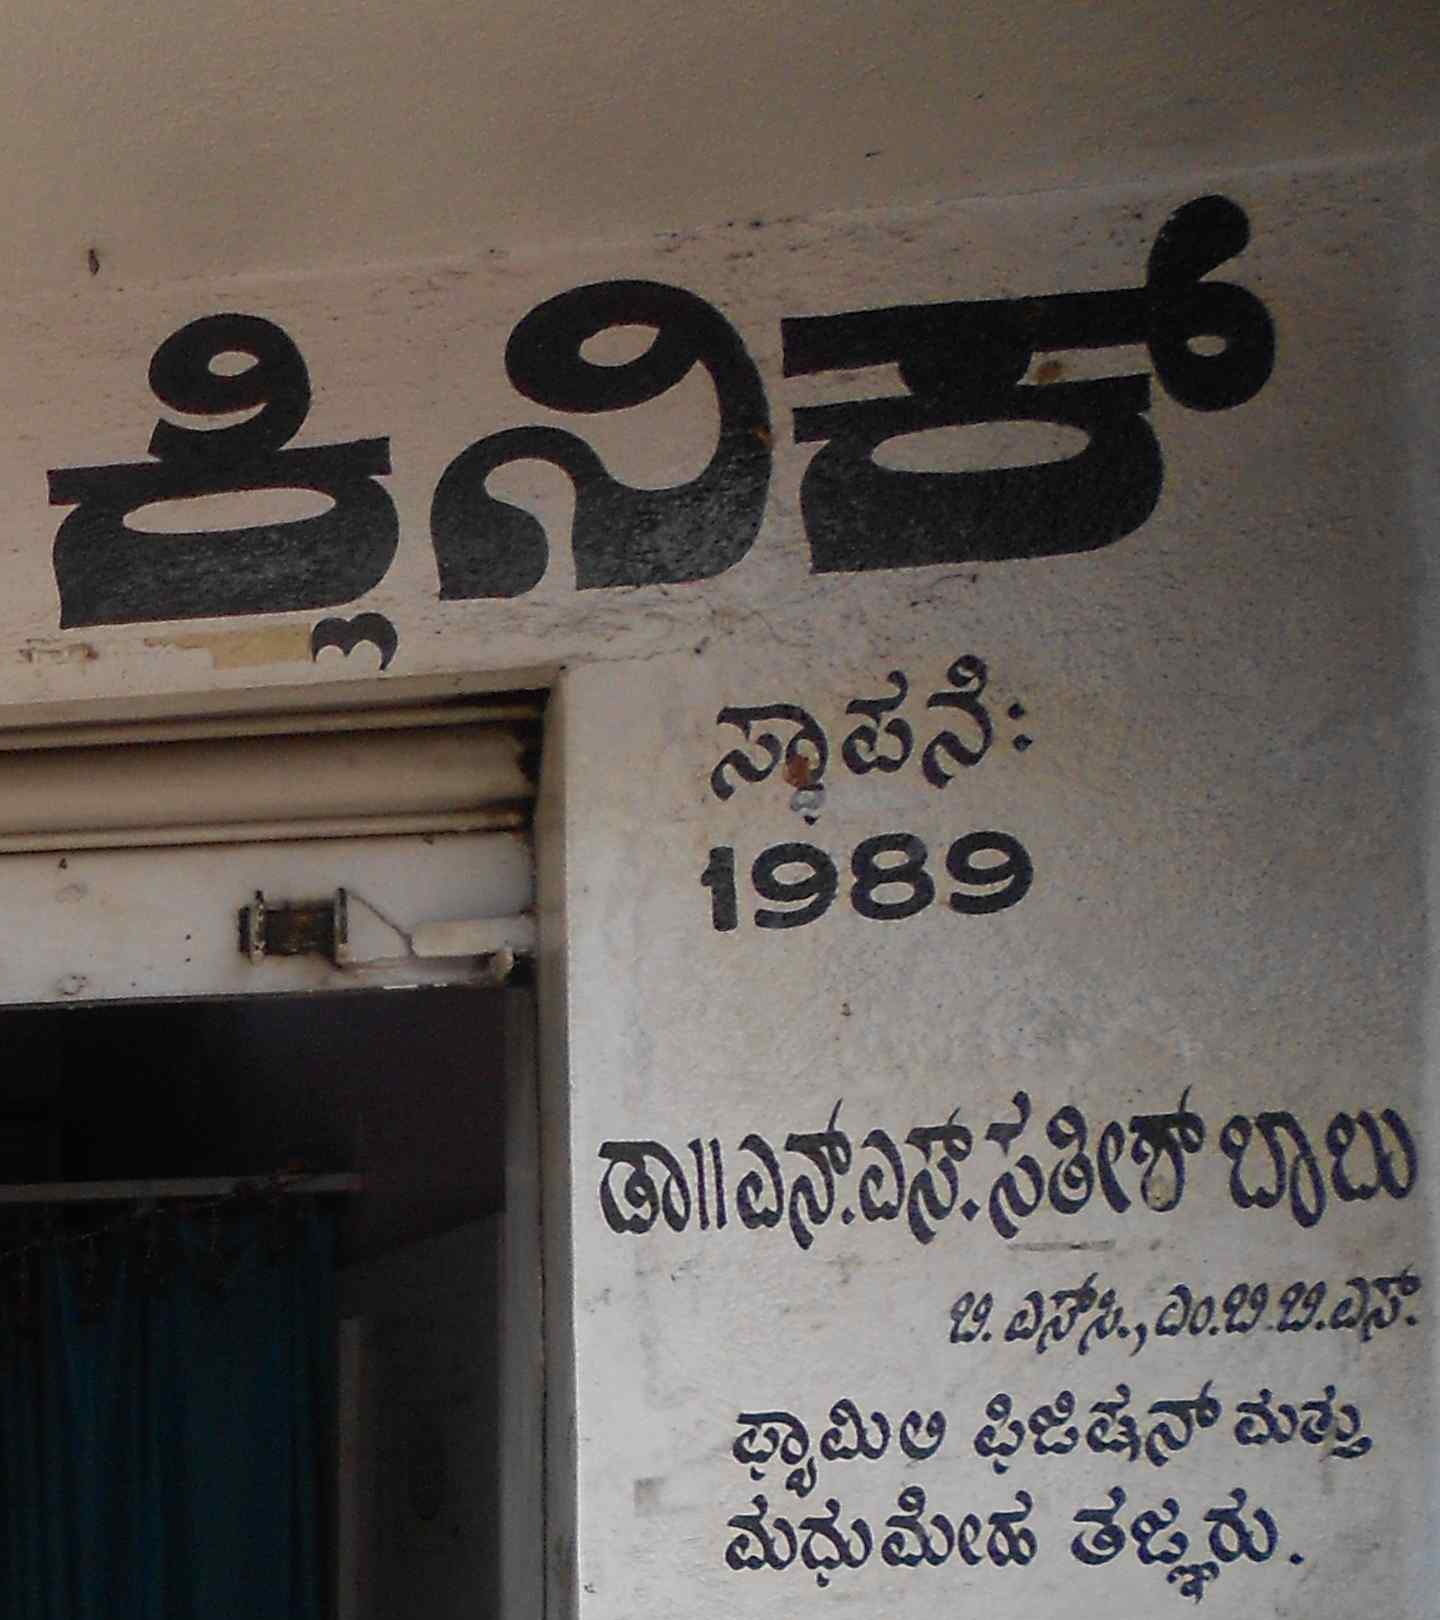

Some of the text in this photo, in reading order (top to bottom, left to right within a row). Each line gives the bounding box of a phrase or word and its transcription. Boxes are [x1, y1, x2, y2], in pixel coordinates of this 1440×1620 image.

[46, 195, 1277, 672] ಕ್ಲಿನಿಕ್
[700, 830, 1034, 932] 1989
[1233, 1384, 1373, 1460] ಮತ್ತು
